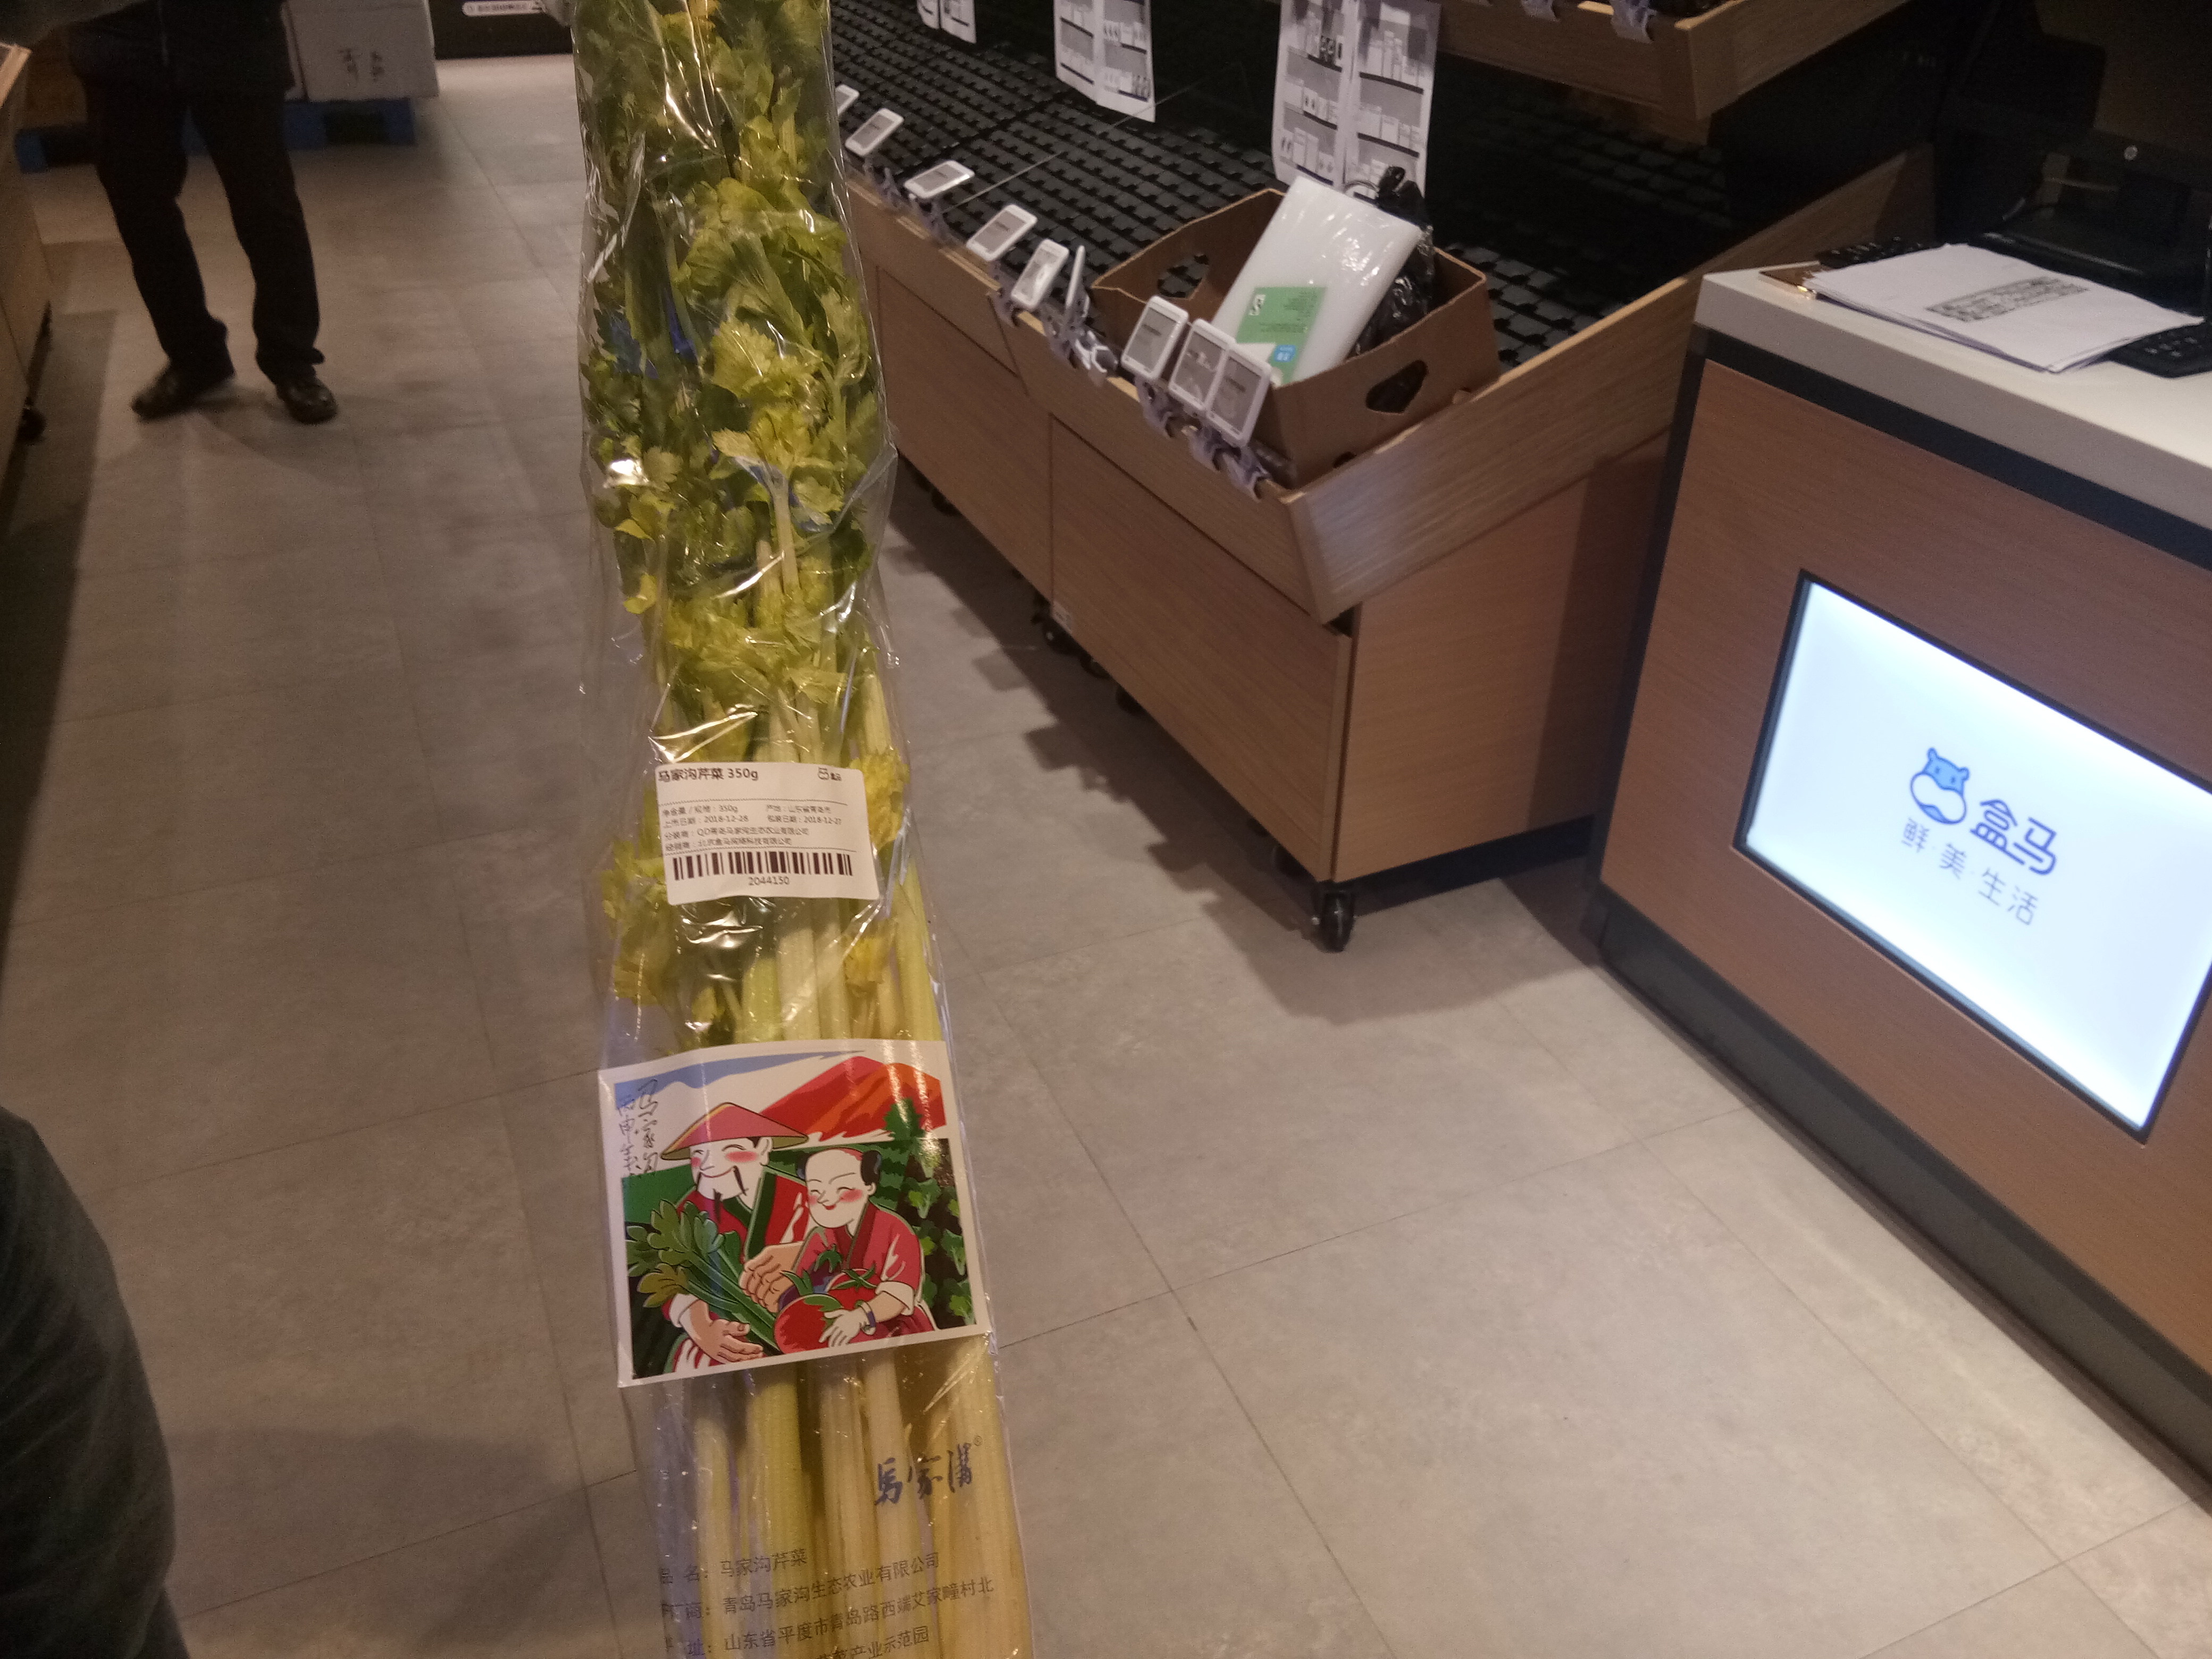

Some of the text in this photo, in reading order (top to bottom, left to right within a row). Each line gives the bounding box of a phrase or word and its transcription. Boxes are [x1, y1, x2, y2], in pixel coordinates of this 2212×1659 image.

[658, 767, 759, 783] 马家沟芹菜 350g
[1970, 799, 2057, 876] 盒马
[748, 875, 790, 886] 2044150
